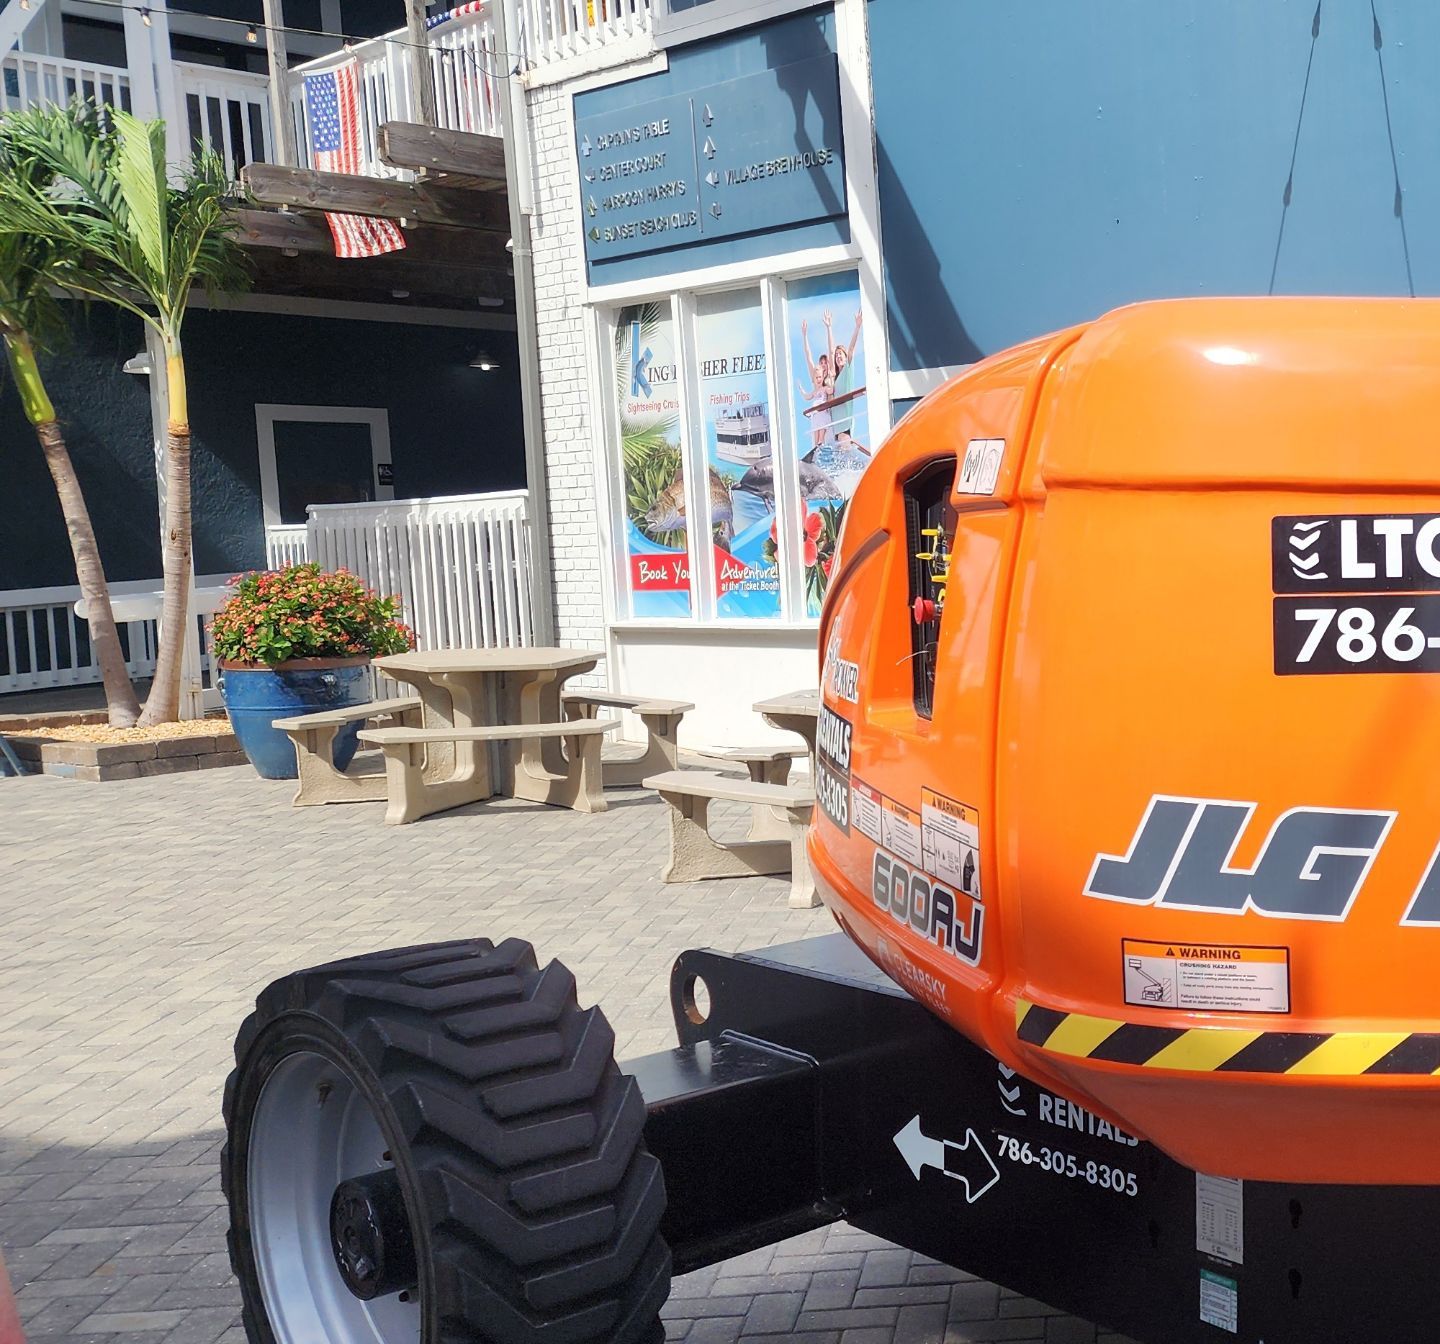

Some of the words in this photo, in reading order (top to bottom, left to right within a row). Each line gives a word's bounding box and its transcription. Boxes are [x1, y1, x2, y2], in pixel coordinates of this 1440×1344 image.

[642, 119, 671, 139] TABLE
[599, 161, 636, 181] CENTER
[635, 152, 667, 174] COURT
[724, 164, 765, 186] VILLAGE
[765, 147, 834, 177] BREWHOUSE
[602, 189, 646, 212] HARPOON
[604, 223, 640, 243] SUNSET
[640, 215, 671, 236] BEACH
[670, 210, 698, 229] CLUB
[627, 401, 662, 414] Sightseeing
[710, 393, 733, 406] Fishing
[735, 392, 750, 405] Trips
[638, 560, 668, 584] Book
[729, 581, 739, 591] the
[739, 580, 760, 592] Ticket
[760, 581, 780, 591] Booth
[937, 797, 967, 822] WARNING
[1082, 793, 1398, 923] JLG
[873, 848, 985, 968] 600AJ
[1179, 947, 1242, 960] WARNING
[998, 1134, 1138, 1197] 786-305-8305
